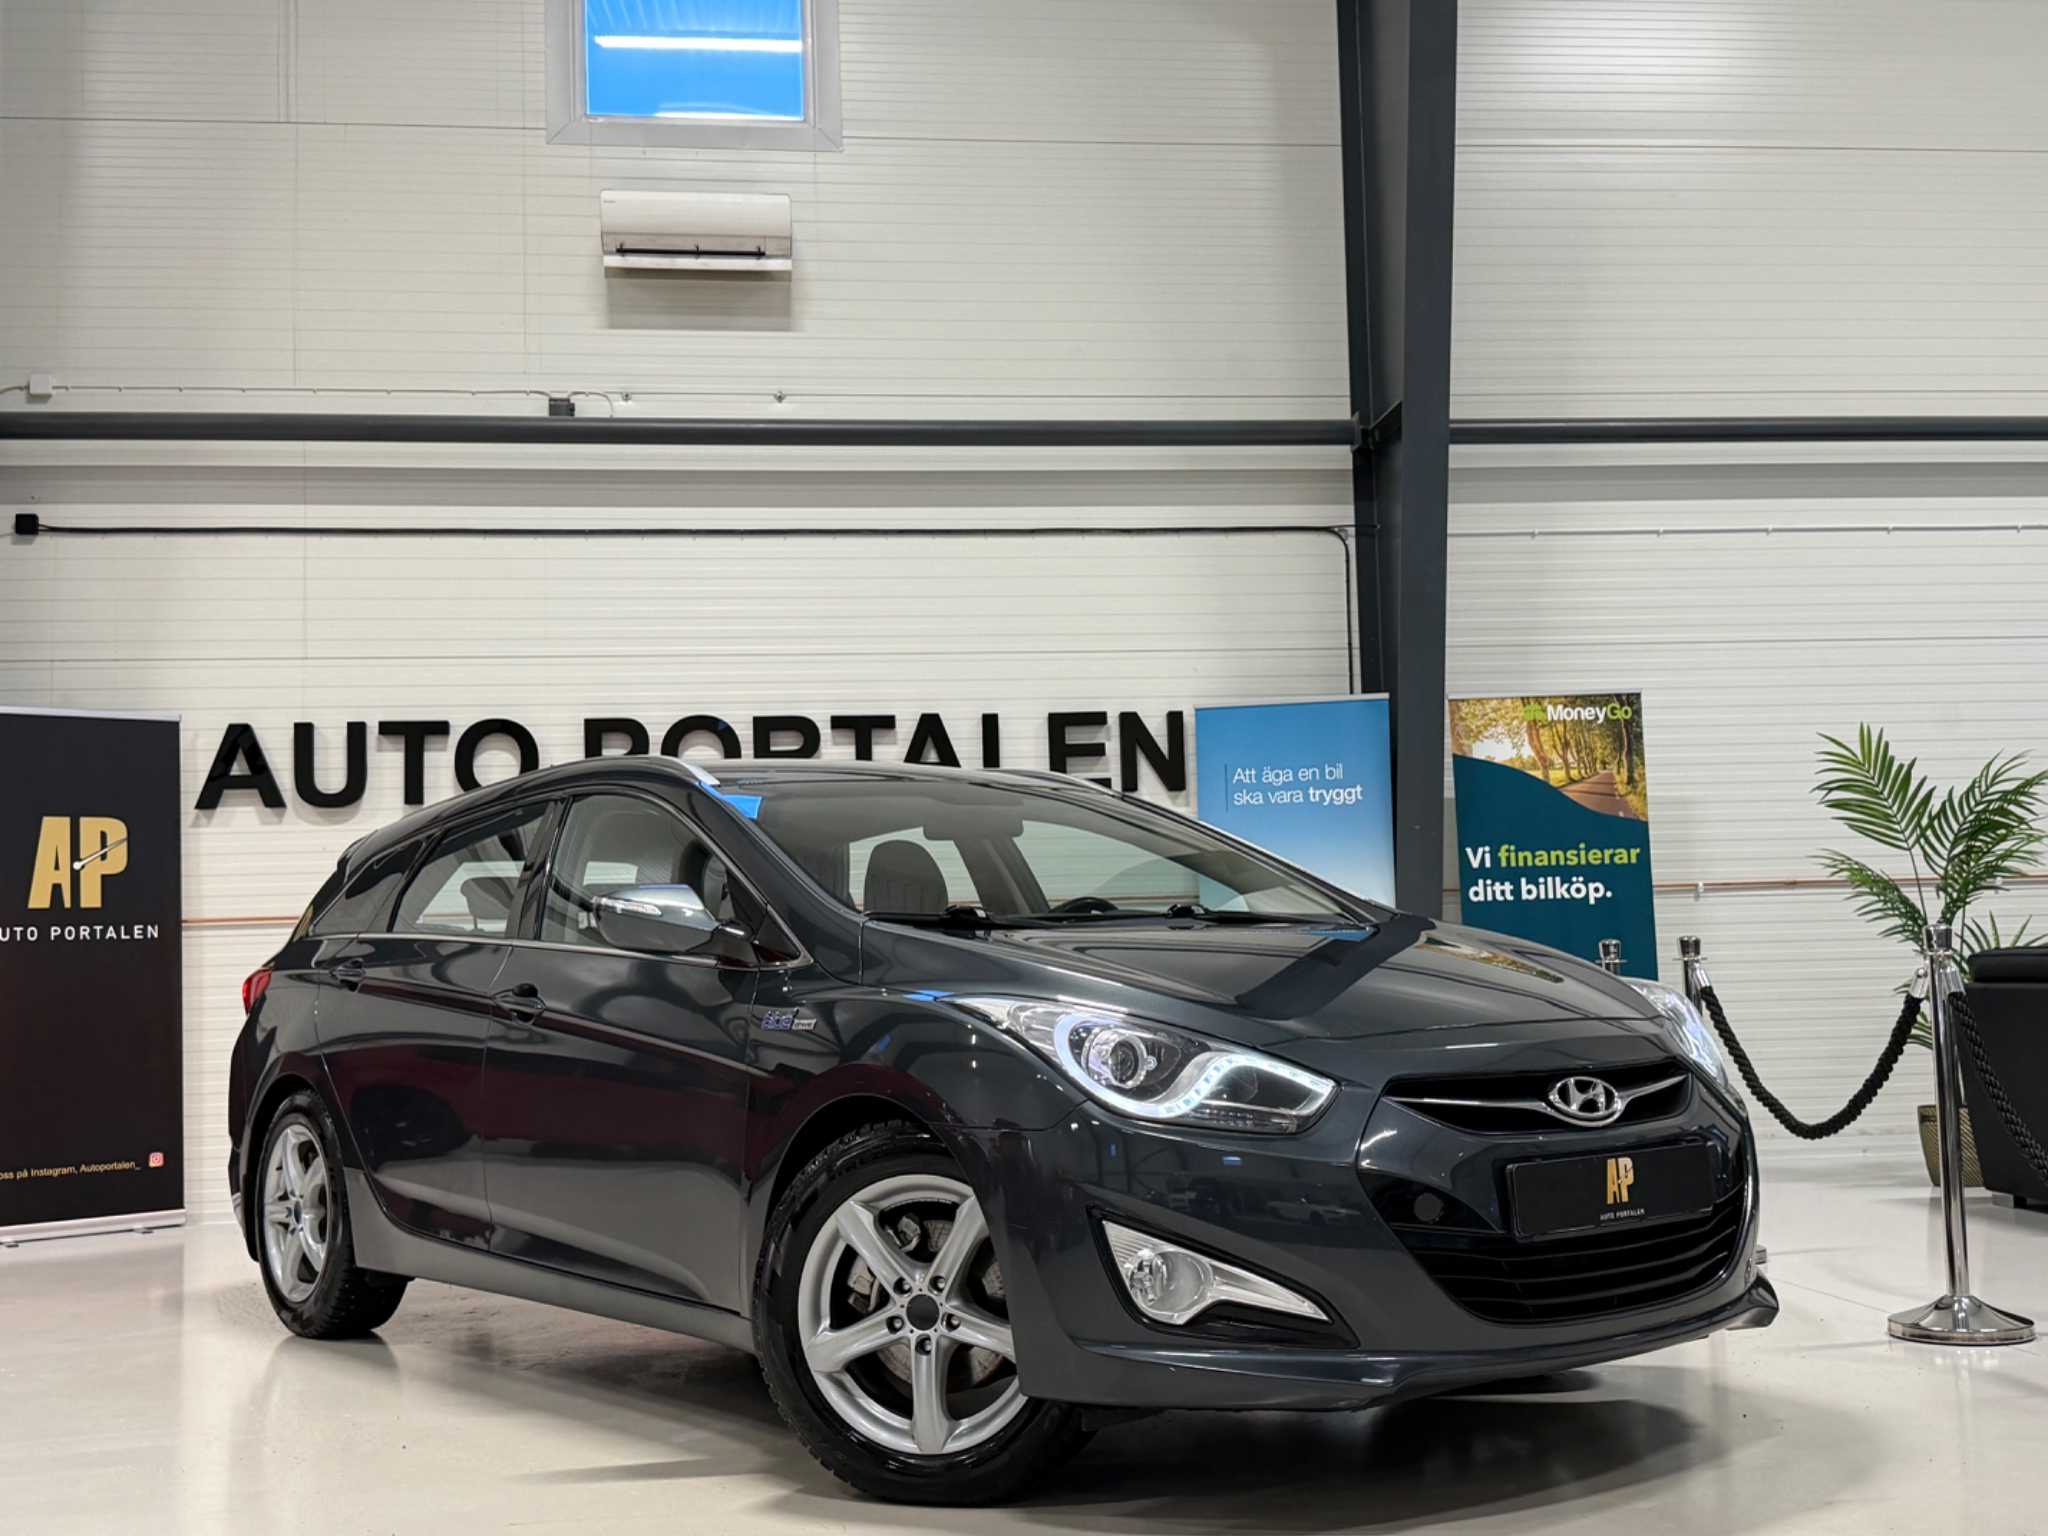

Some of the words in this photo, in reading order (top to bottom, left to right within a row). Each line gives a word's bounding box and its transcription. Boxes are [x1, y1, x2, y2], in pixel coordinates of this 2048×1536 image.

[1546, 703, 1633, 724] MoneyGo
[195, 717, 540, 810] AUTO
[1232, 767, 1257, 784] Att
[1261, 766, 1293, 786] äga
[1298, 767, 1320, 782] en
[1324, 763, 1344, 780] bil
[1233, 789, 1264, 806] ska
[1268, 789, 1304, 804] vara
[1308, 784, 1363, 806] tryggt
[27, 815, 129, 909] AP
[1465, 845, 1492, 869] Vi
[1498, 842, 1641, 868] finansierar
[1468, 878, 1514, 902] ditt
[1520, 876, 1613, 906] bilköp.
[51, 924, 159, 941] PORTALEN
[17, 1168, 28, 1181] på
[31, 1166, 78, 1178] Instagram,
[1606, 1156, 1635, 1205] AP
